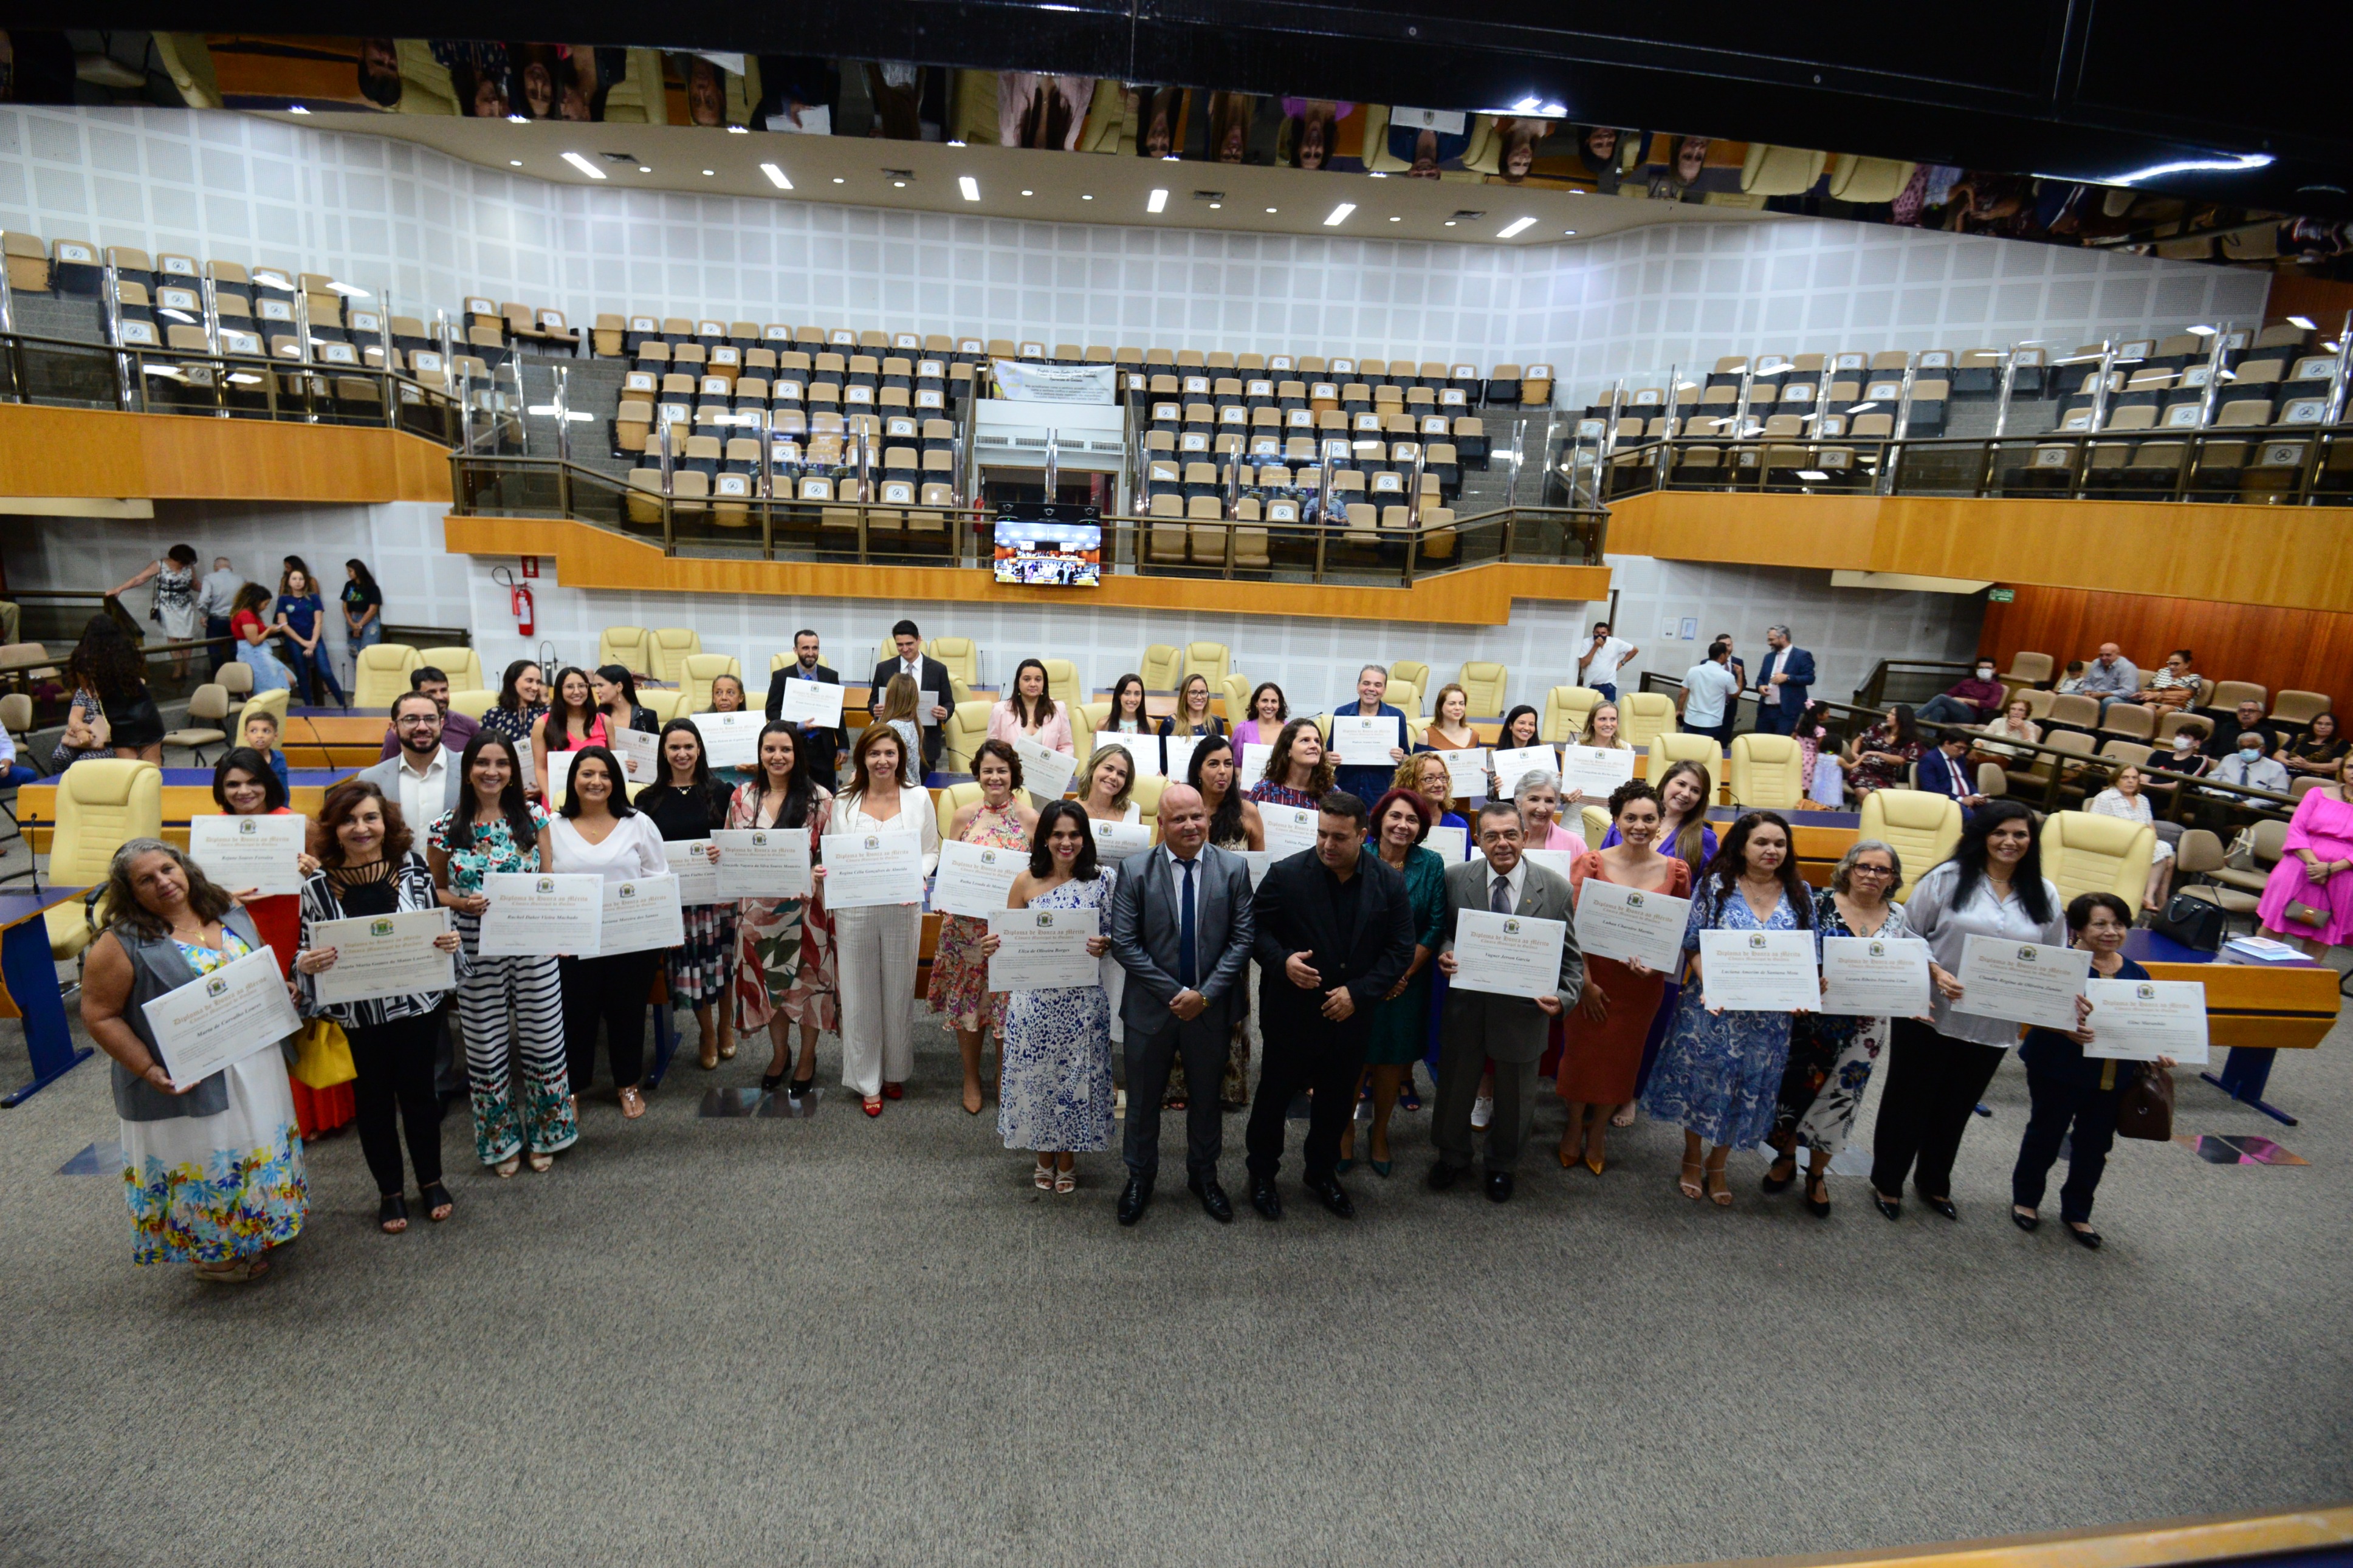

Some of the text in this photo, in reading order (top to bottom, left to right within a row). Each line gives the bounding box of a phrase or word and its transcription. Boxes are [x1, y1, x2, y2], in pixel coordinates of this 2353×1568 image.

[1593, 899, 1618, 910] Diploma
[1627, 907, 1645, 916] Honra
[1654, 912, 1674, 922] Mérito
[1471, 932, 1494, 940] Diploma
[1979, 955, 2006, 966] Diploma
[2018, 961, 2038, 970] Honra
[2049, 965, 2071, 974] Mérito
[173, 1008, 203, 1025] Diploma
[214, 994, 235, 1005] Honra
[246, 976, 267, 990] Mérito
[197, 1028, 213, 1037] Maria
